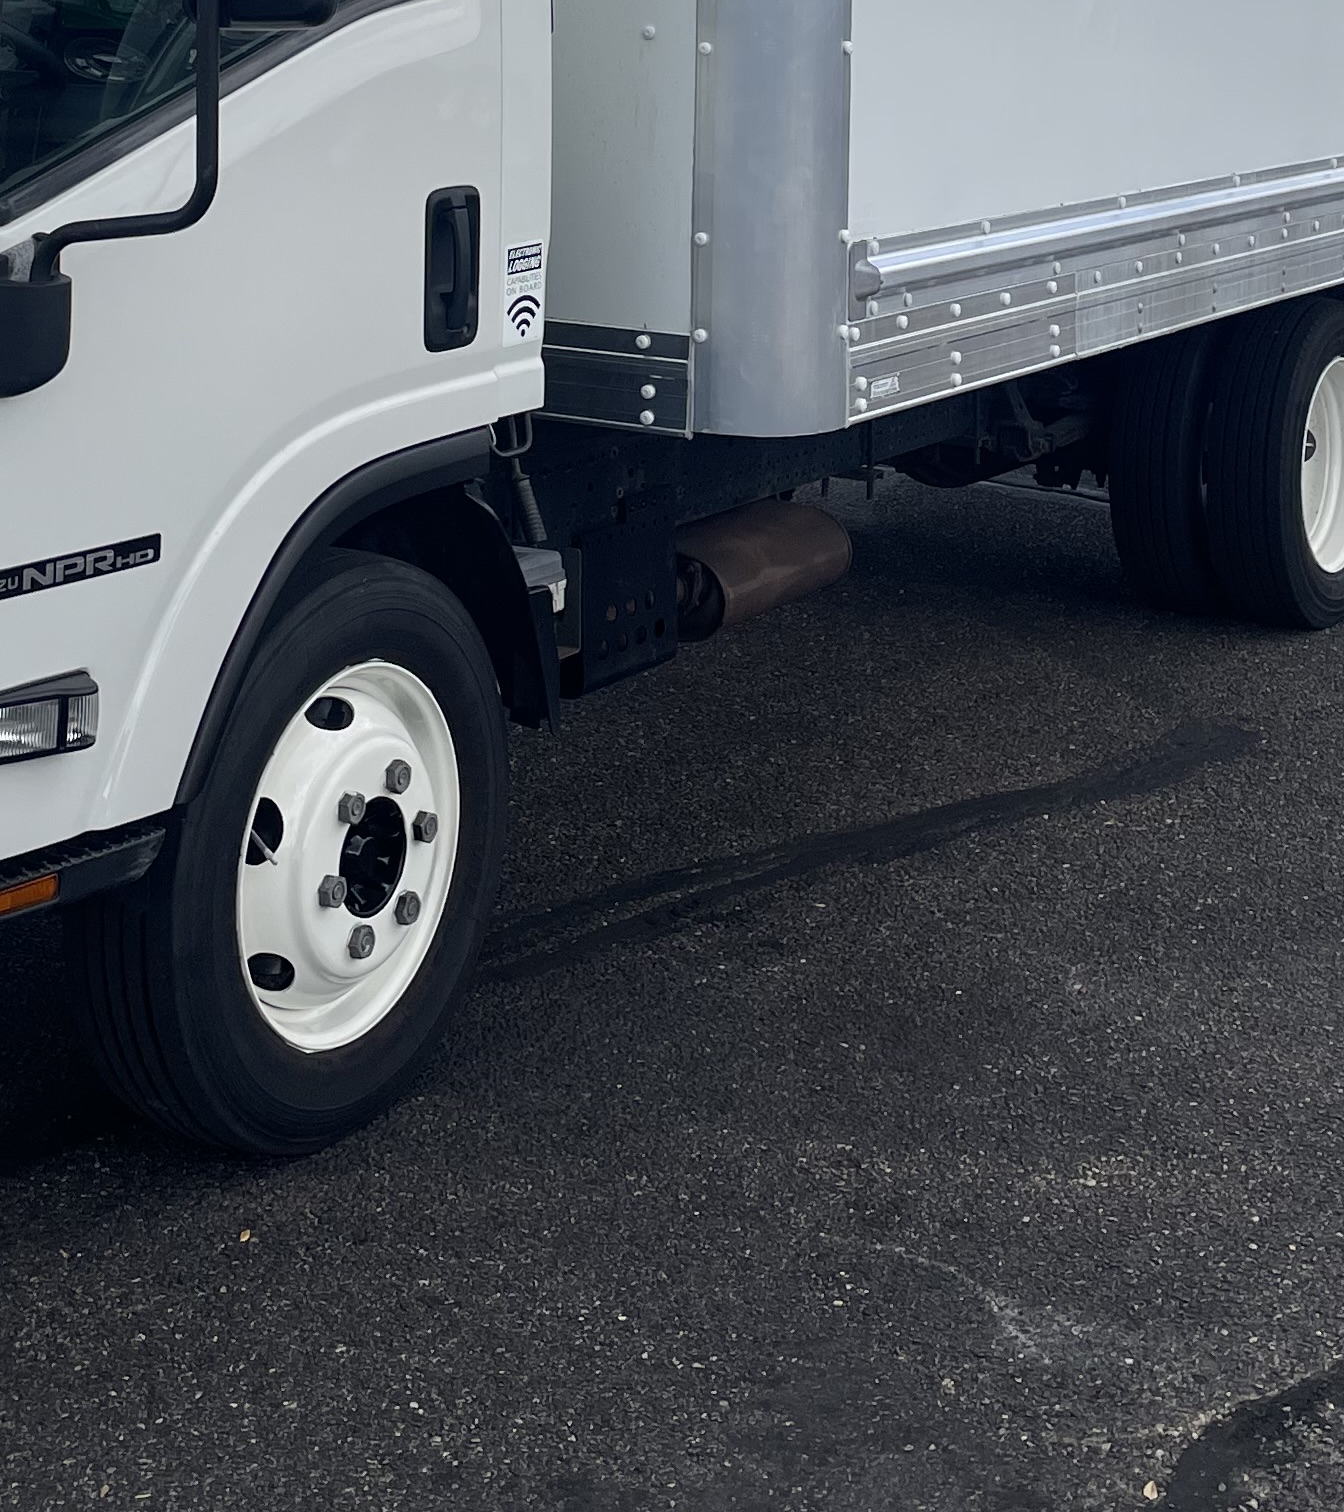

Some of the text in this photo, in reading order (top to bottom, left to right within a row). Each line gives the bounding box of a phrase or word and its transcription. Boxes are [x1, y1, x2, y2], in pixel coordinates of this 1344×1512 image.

[508, 255, 541, 273] LOGGING
[506, 272, 542, 287] CAPABILITIES
[506, 281, 542, 297] ON BOARD
[22, 549, 115, 591] NPR
[115, 548, 155, 568] HD
